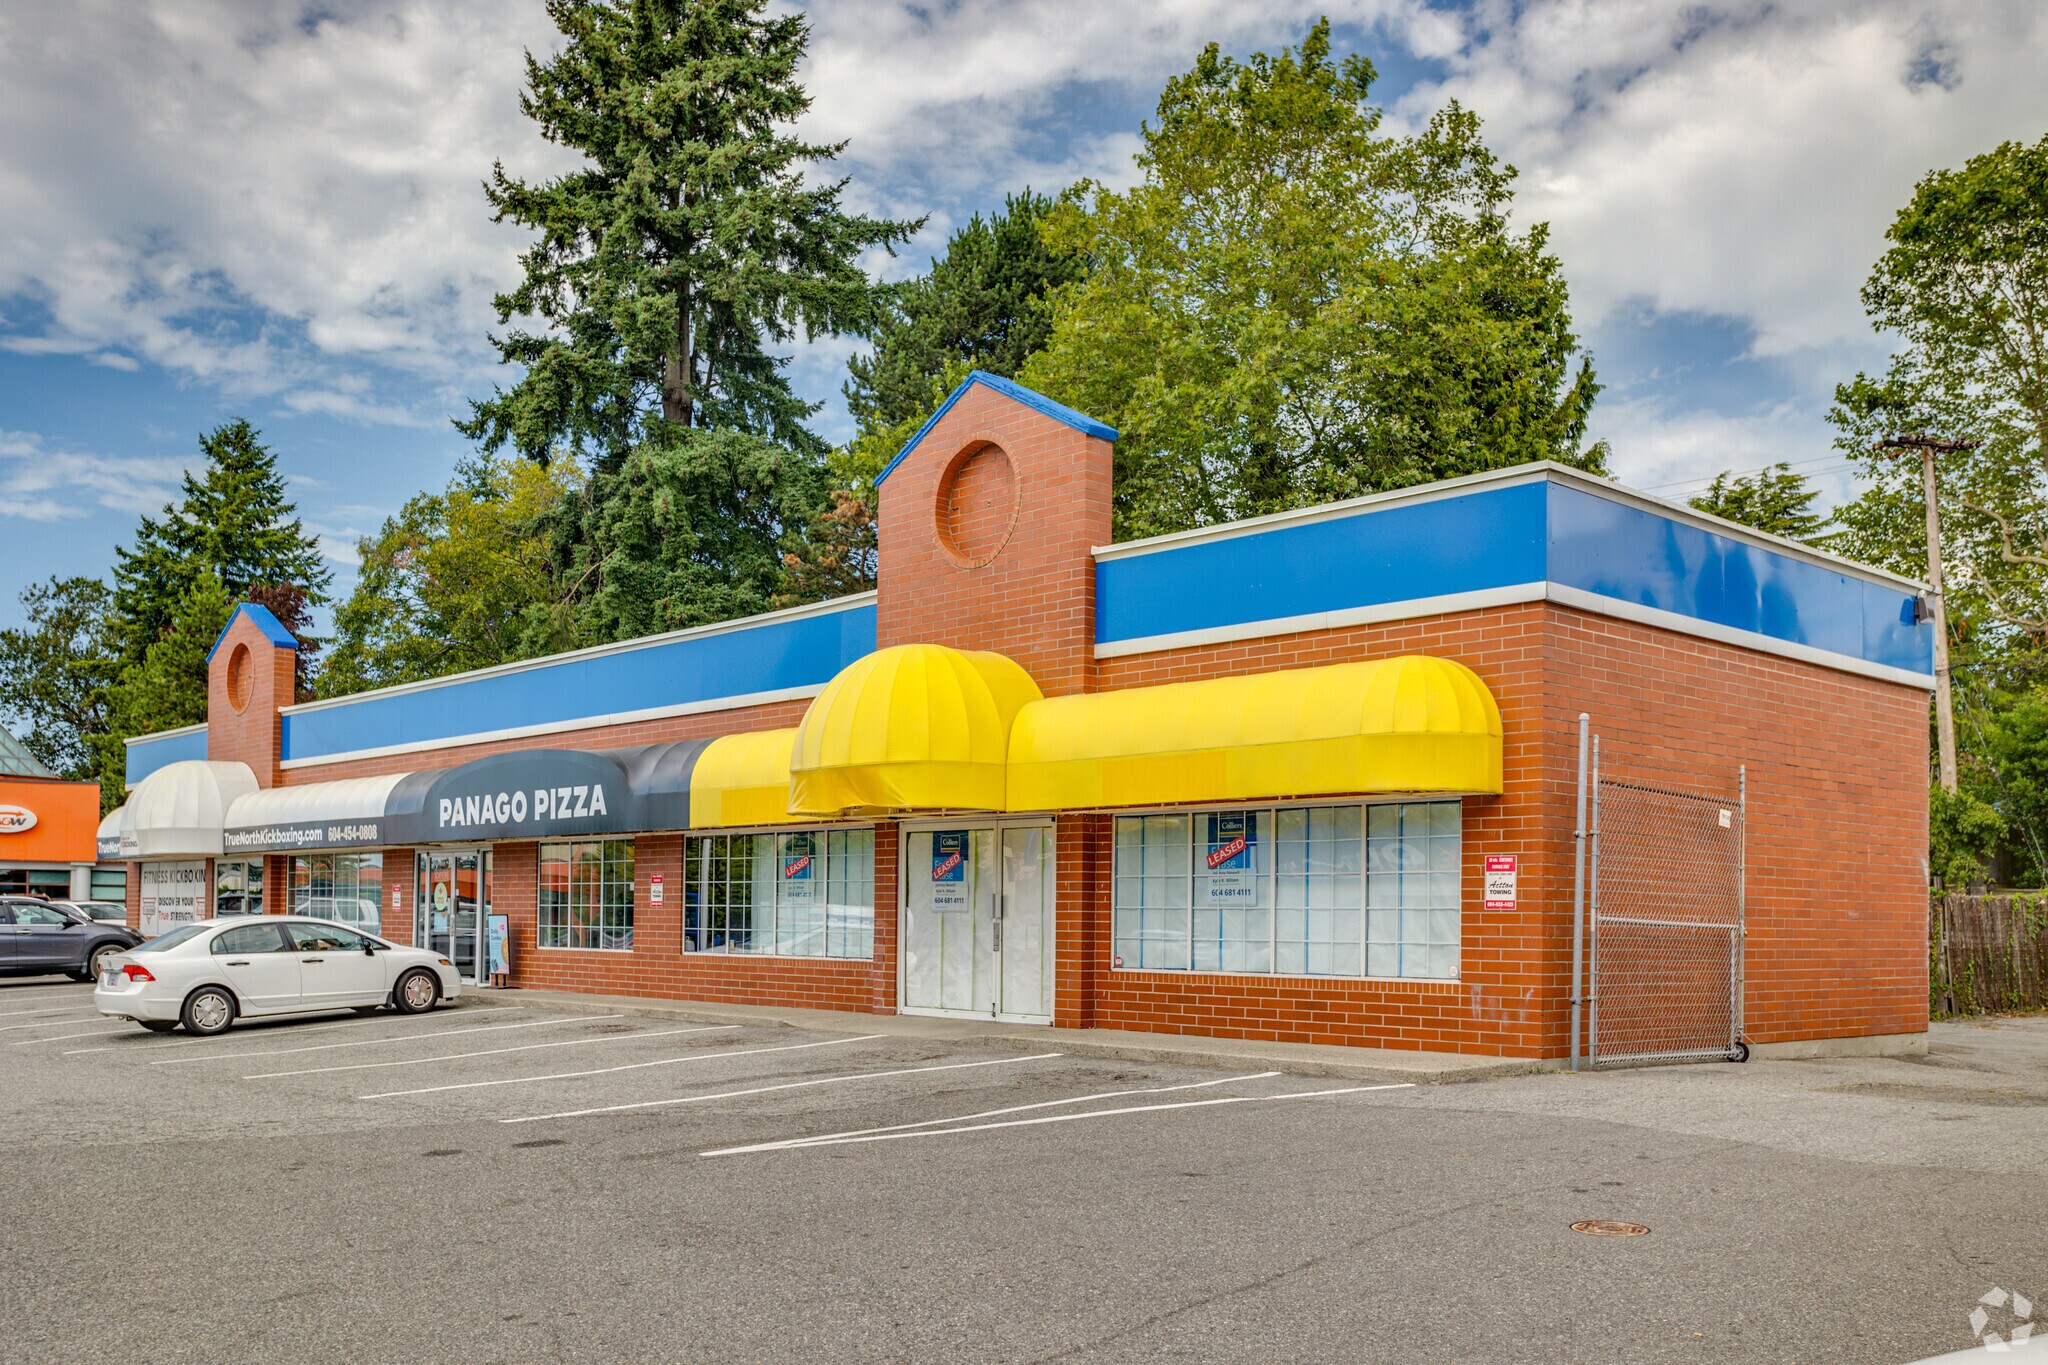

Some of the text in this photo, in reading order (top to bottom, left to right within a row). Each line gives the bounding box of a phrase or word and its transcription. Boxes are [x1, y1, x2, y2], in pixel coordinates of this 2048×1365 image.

[439, 784, 608, 828] PANAGO PIZZA
[1221, 821, 1242, 830] Colliers
[224, 824, 378, 846] TrueNorthKickboxing.com 604-454-0808
[1208, 839, 1244, 866] LEASED
[786, 855, 810, 876] LEASED
[933, 853, 961, 879] LEASED
[143, 870, 169, 884] FITNESS
[1224, 889, 1236, 897] 681
[1237, 888, 1251, 896] 4111
[158, 897, 194, 906] DISCOVER YOUR
[170, 911, 194, 921] STRENGTH
